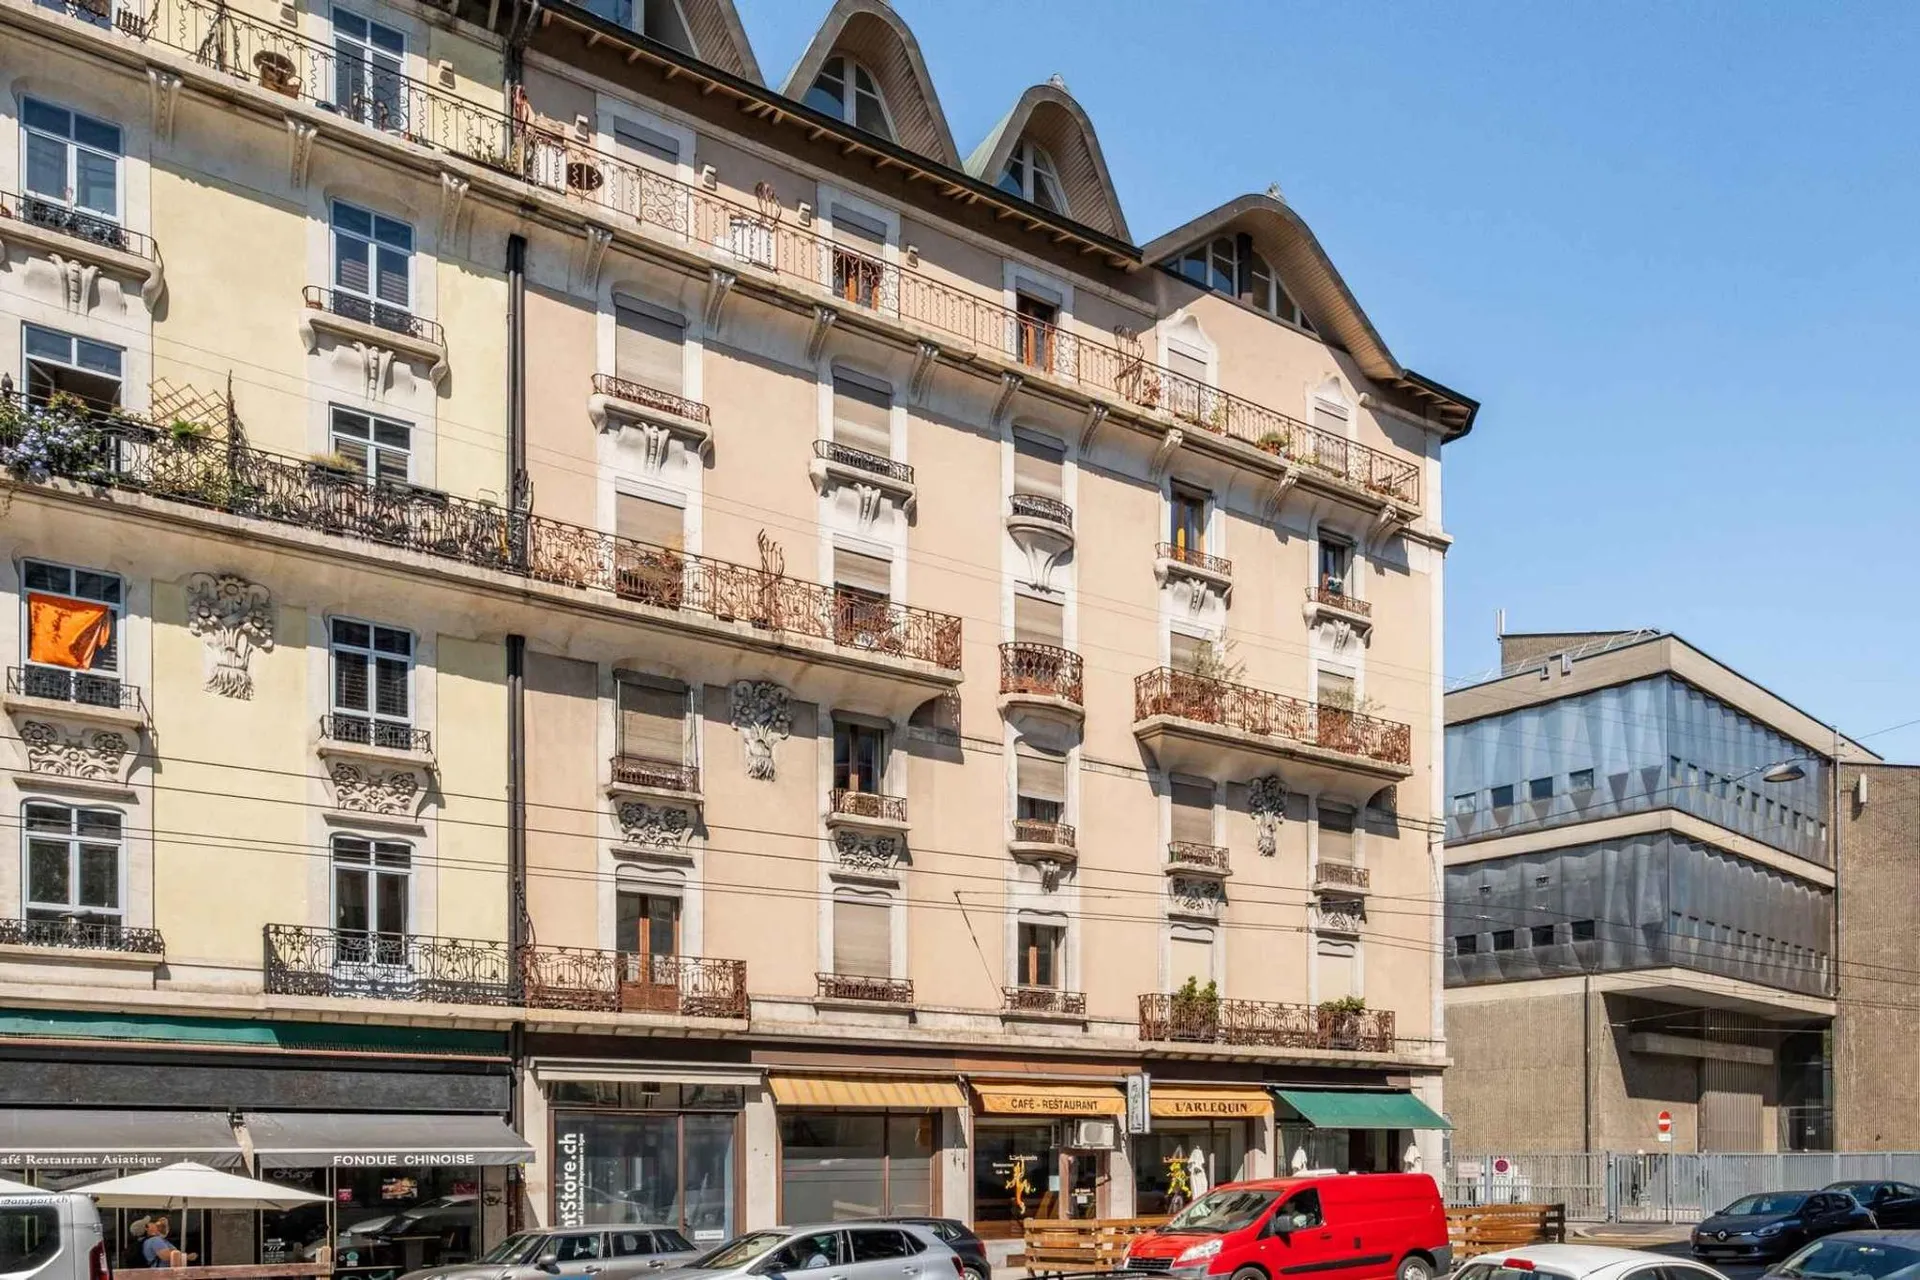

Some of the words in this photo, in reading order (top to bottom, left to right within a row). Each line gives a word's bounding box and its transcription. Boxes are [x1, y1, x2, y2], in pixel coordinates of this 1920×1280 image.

[1011, 1098, 1035, 1109] CAFÉ
[1042, 1098, 1099, 1111] RESTAURANT
[1175, 1101, 1249, 1114] L'ARLEQUIN
[26, 1154, 97, 1165] Restaurant
[102, 1154, 162, 1166] Asiatique
[333, 1154, 397, 1166] FONDUE
[404, 1154, 476, 1165] CHINOISE
